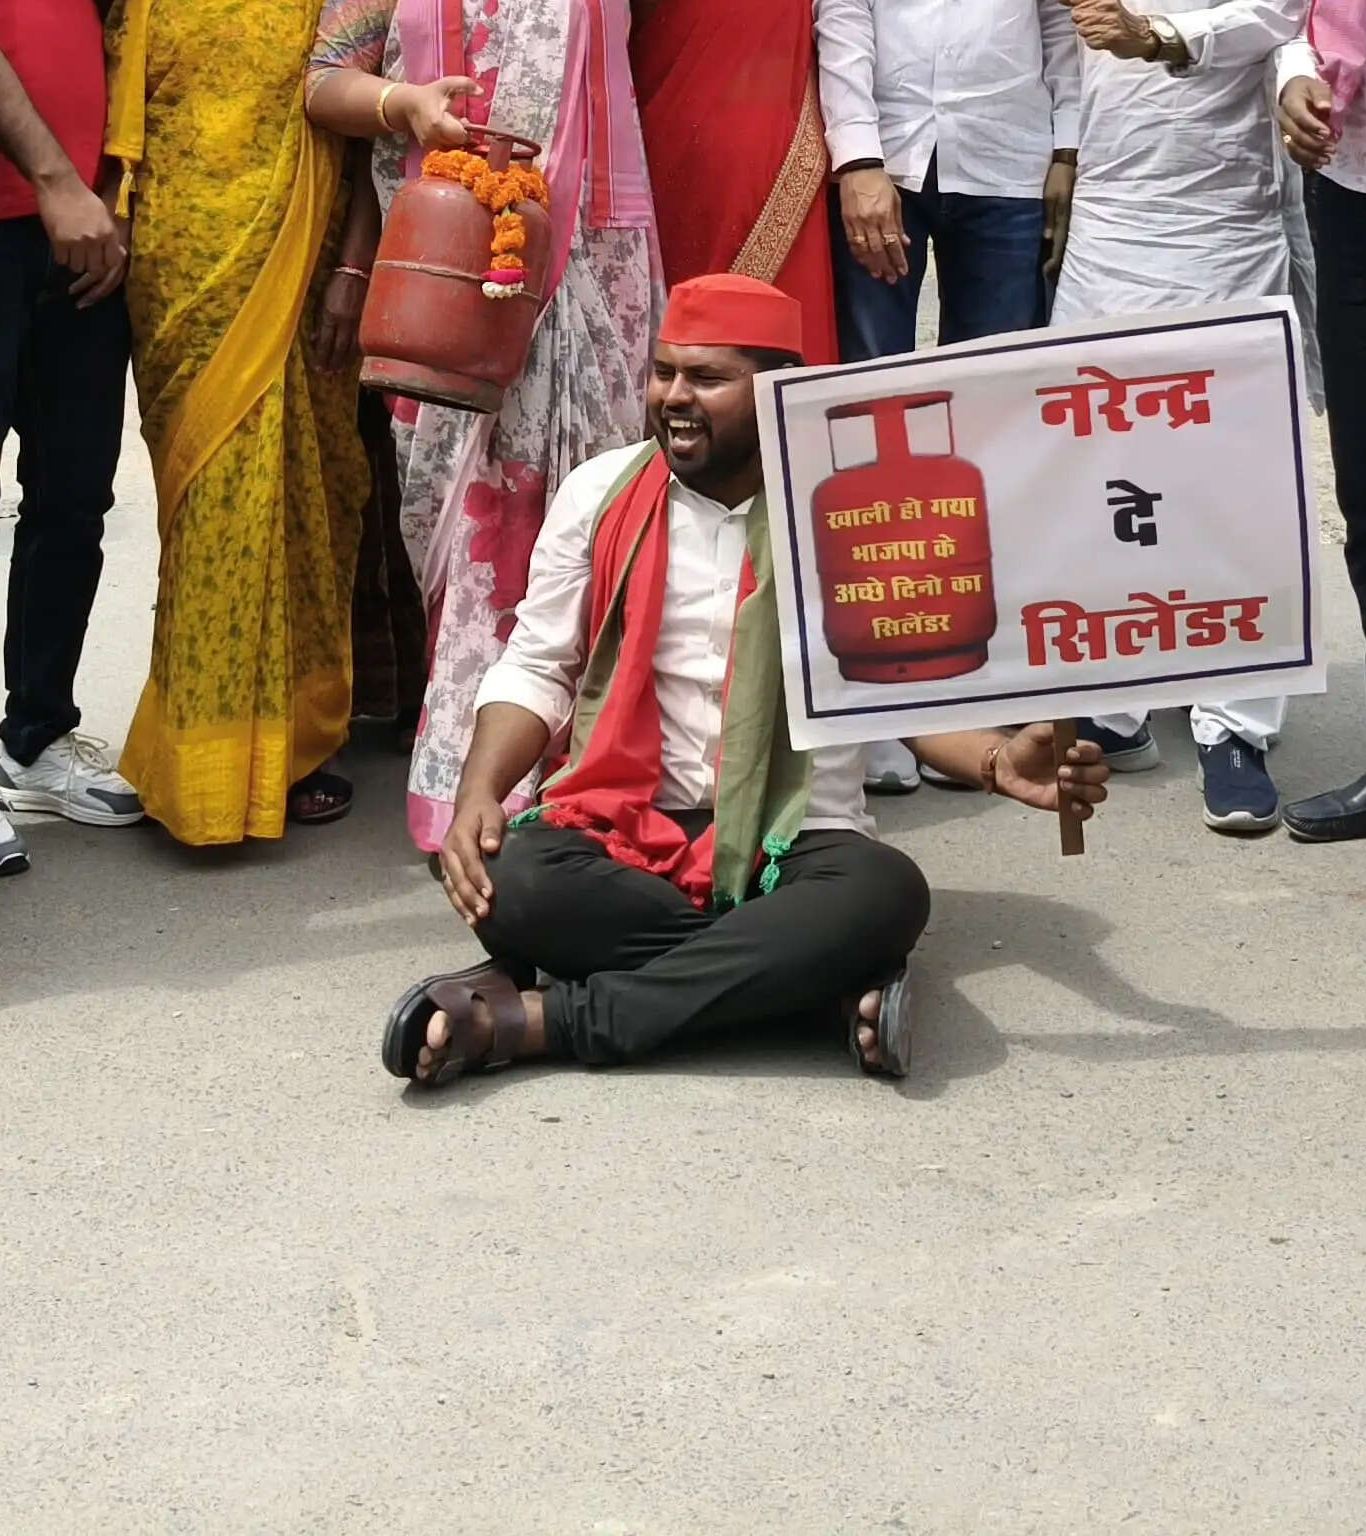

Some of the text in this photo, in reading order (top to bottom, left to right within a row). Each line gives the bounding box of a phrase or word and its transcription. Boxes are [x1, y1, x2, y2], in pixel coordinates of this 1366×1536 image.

[1036, 366, 1214, 437] नरेन्द्र
[825, 496, 977, 530] खाली हो गया
[1106, 480, 1162, 546] दे
[851, 534, 957, 562] भाजपा के
[834, 574, 983, 603] अच्छे दिनो का
[871, 611, 951, 639] सिलेंडर
[1021, 589, 1268, 666] सिलेंडर
